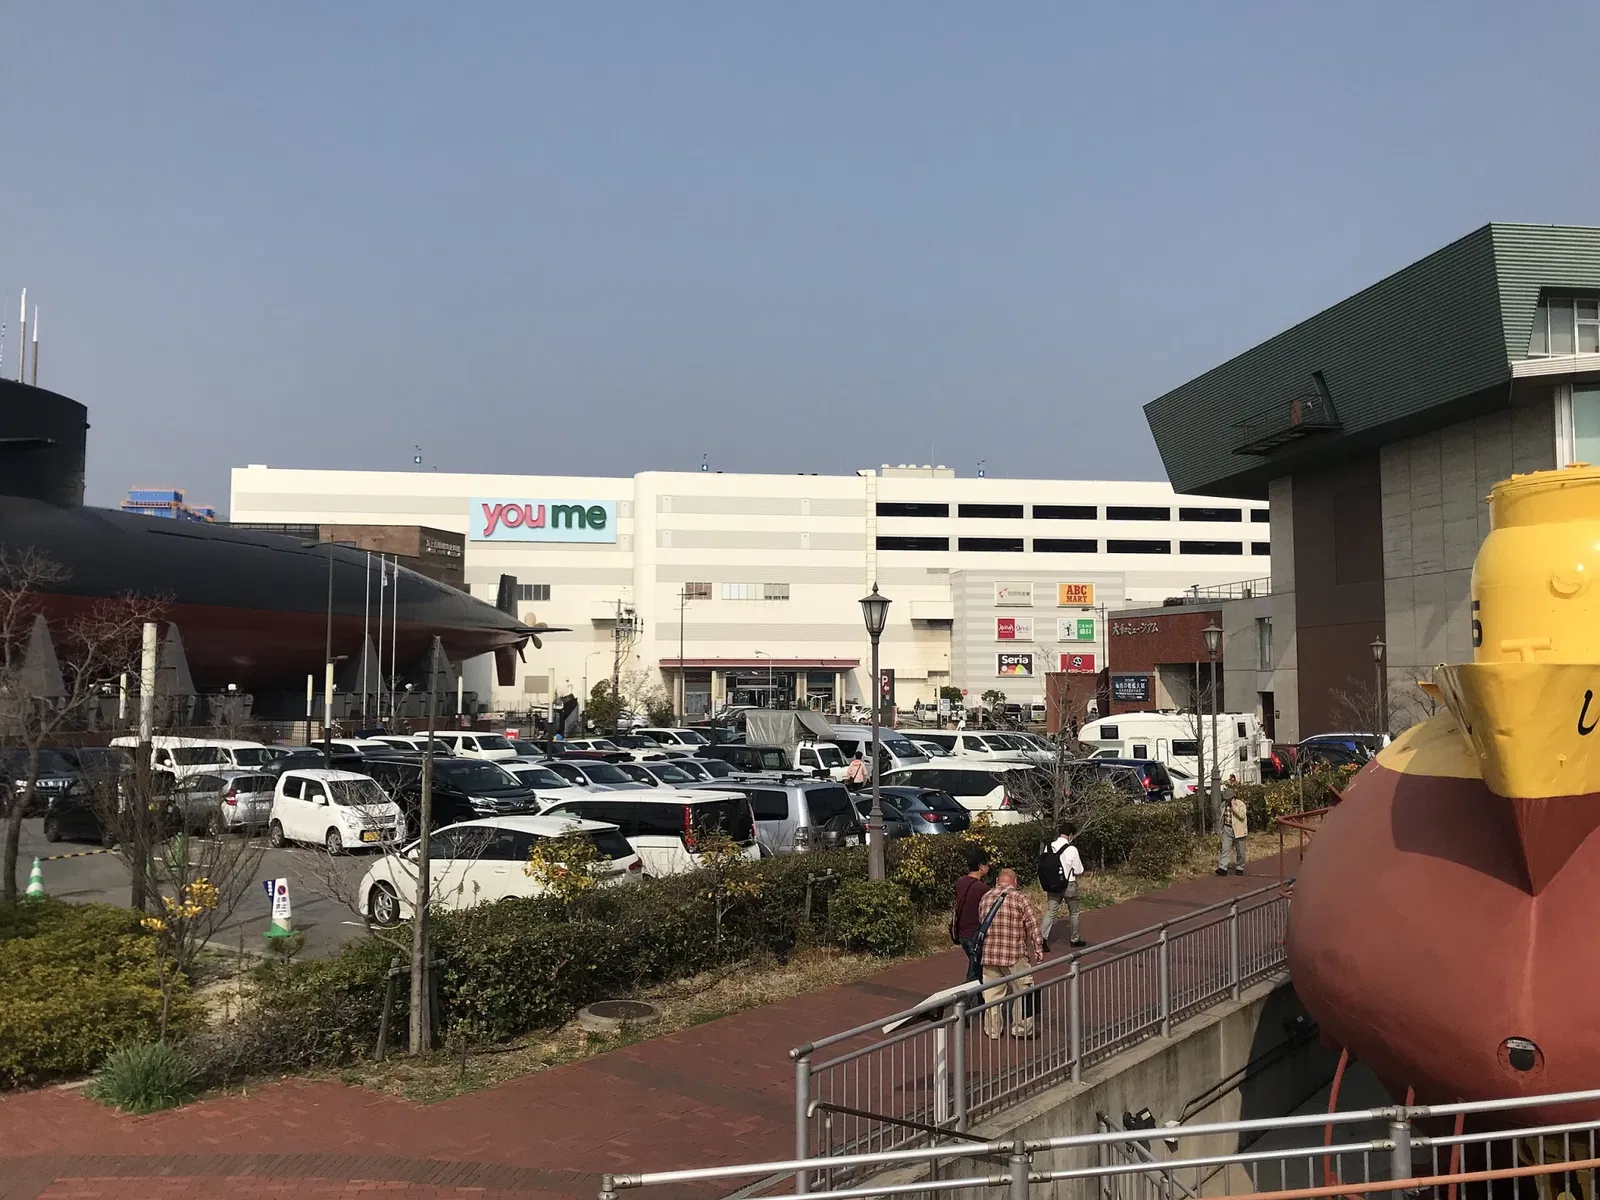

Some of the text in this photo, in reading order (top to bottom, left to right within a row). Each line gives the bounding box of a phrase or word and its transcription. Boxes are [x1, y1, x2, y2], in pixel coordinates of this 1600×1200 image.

[1066, 584, 1087, 595] ABC
[1066, 595, 1087, 603] MART
[1112, 622, 1159, 637] 大和ミュージアム
[1001, 655, 1029, 664] Seria
[881, 675, 888, 686] P
